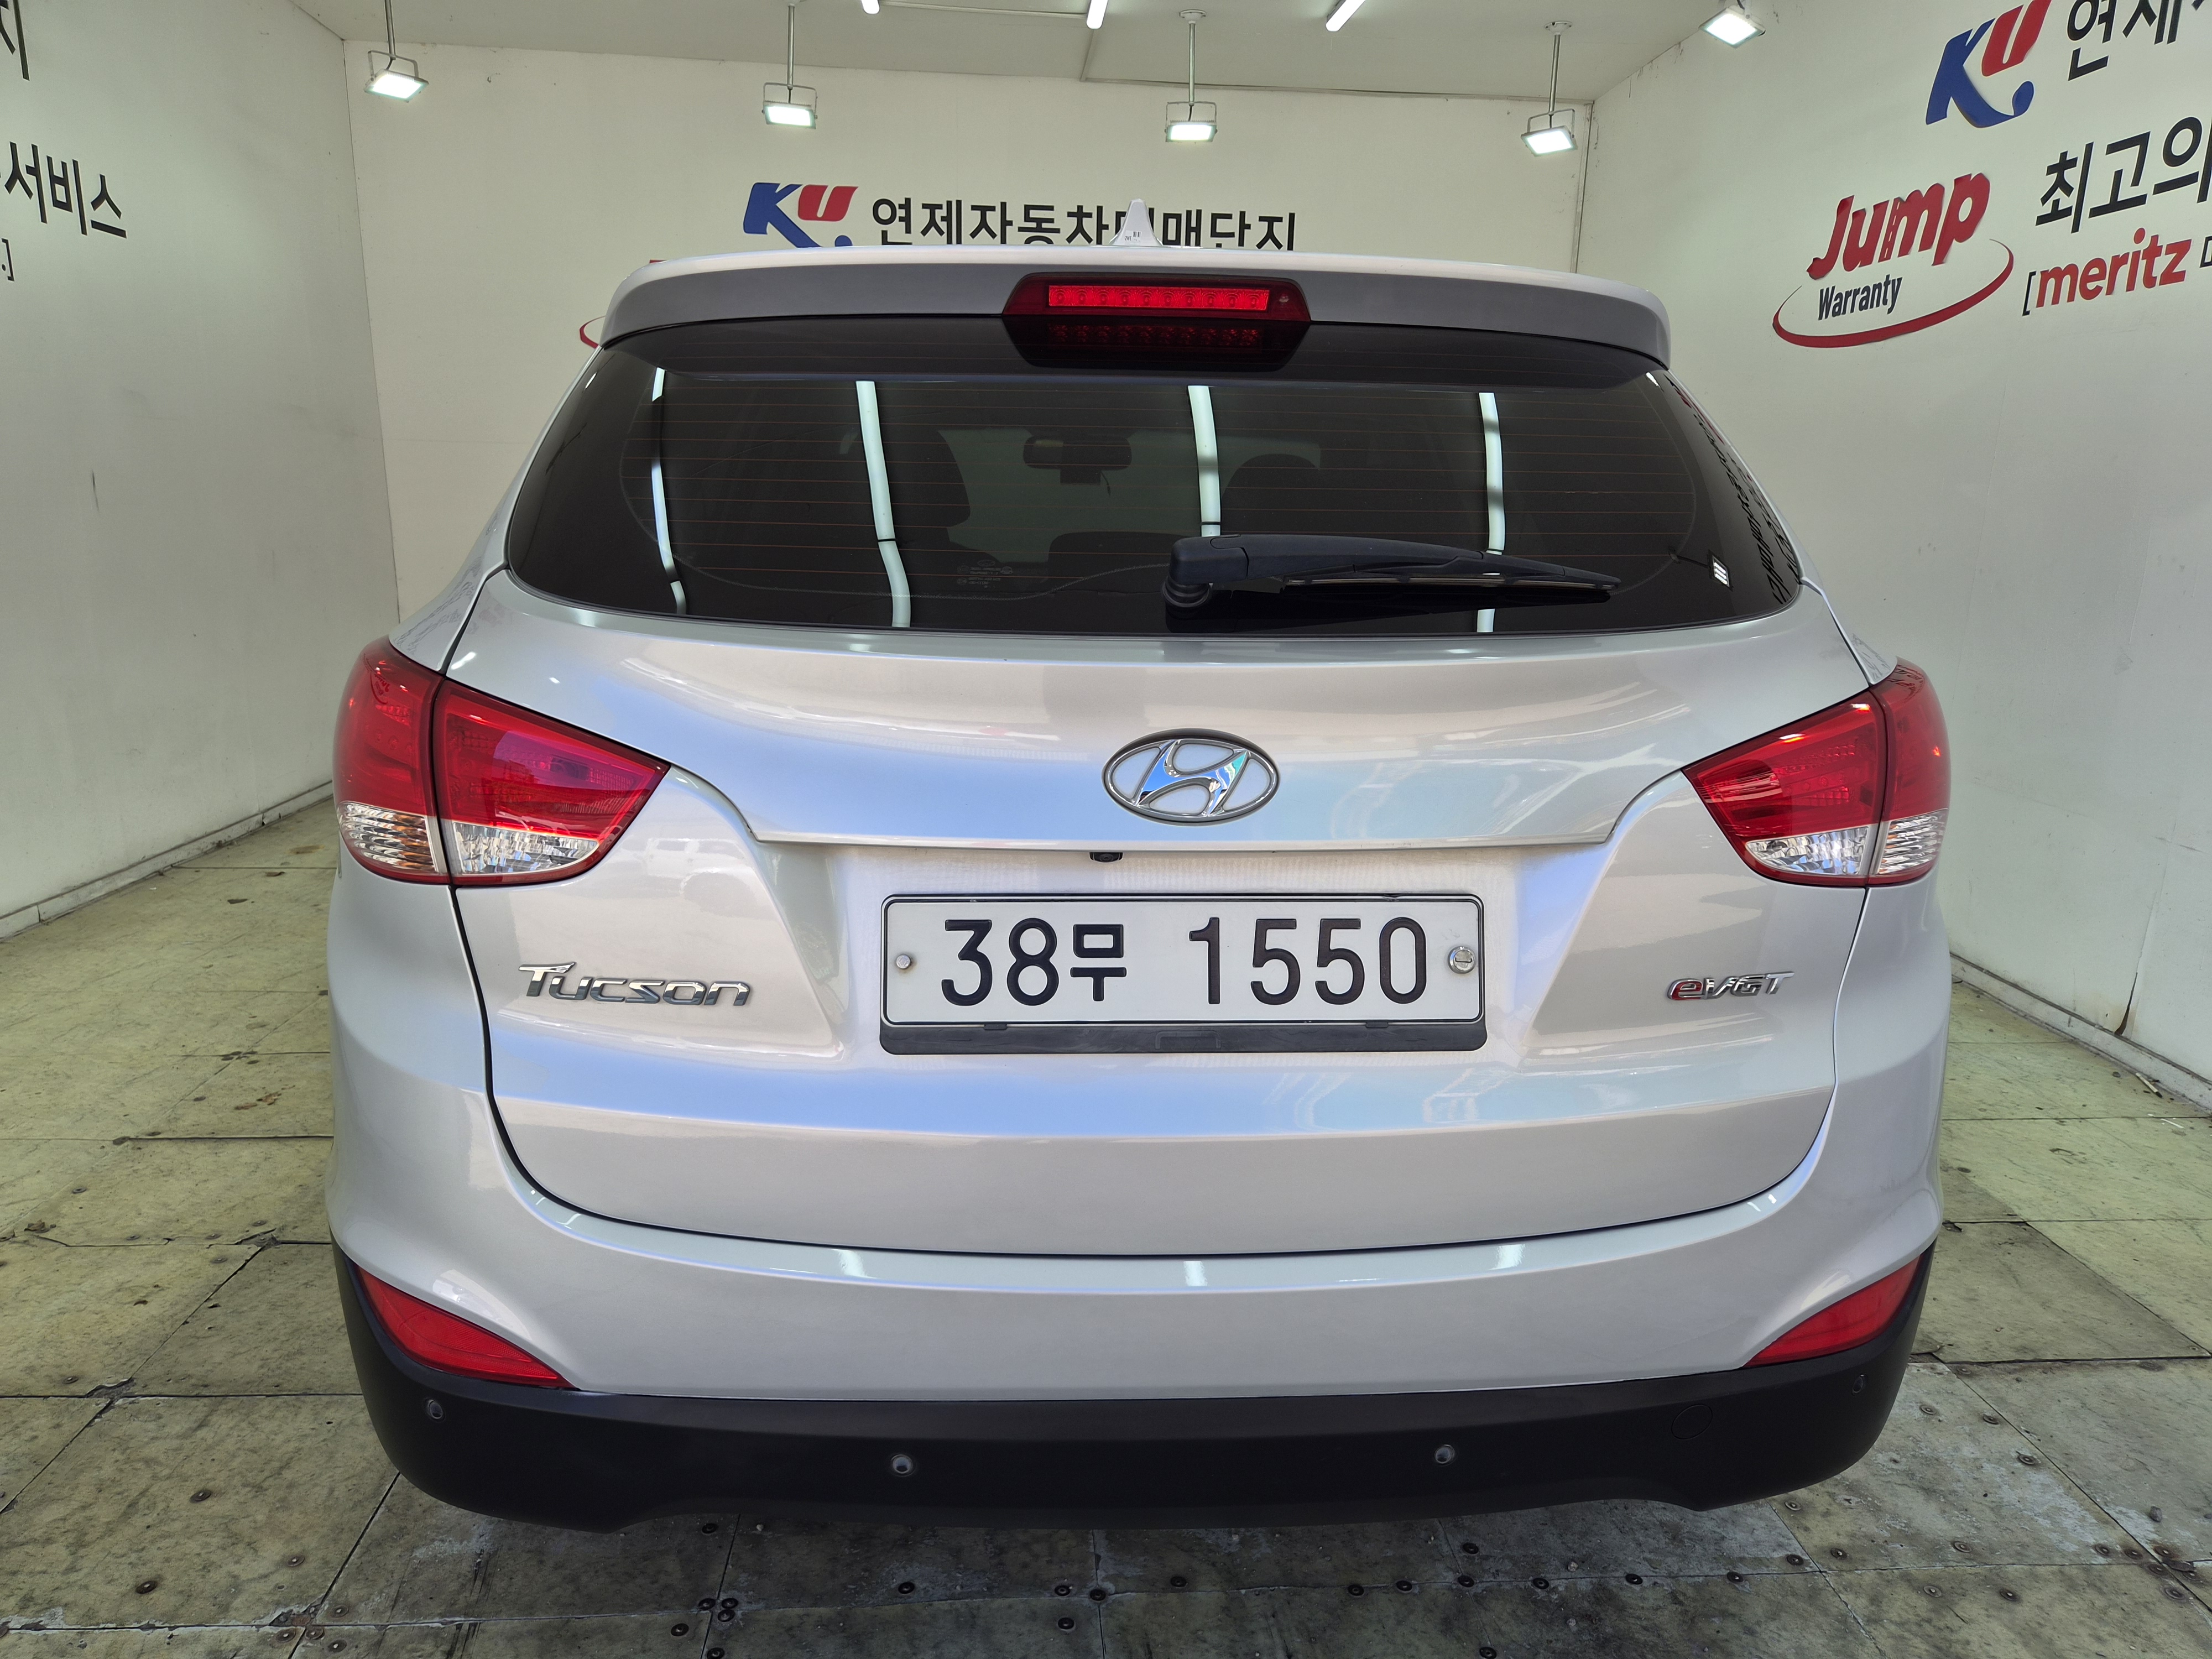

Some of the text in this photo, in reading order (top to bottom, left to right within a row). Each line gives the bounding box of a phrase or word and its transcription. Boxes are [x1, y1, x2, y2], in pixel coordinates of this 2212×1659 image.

[0, 142, 127, 239] 서비스
[2035, 117, 2212, 234] 최고의
[1807, 173, 1990, 280] Jump
[1818, 274, 1903, 322] Warranty
[941, 916, 1427, 1007] 38무 1550
